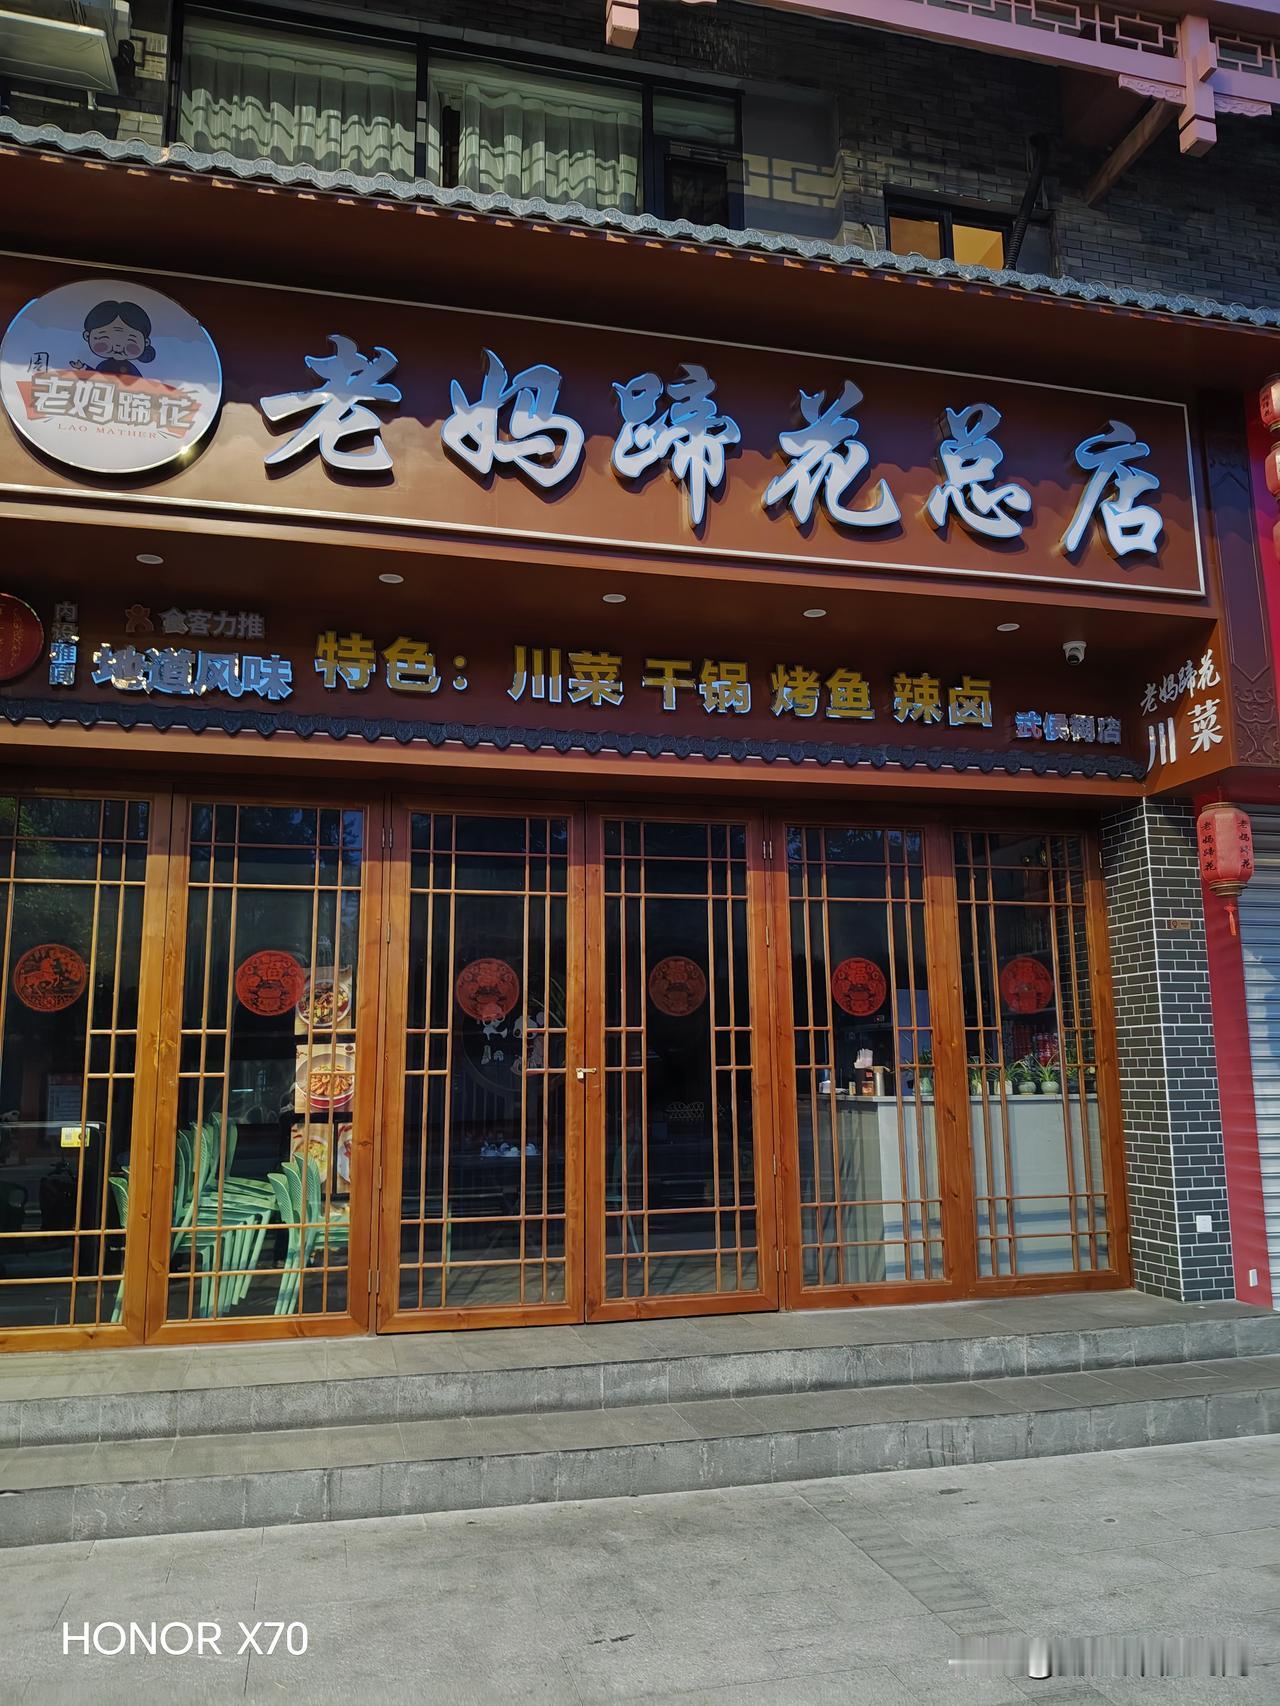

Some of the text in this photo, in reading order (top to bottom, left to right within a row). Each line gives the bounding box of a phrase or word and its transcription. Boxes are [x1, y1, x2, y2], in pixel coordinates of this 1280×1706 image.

[27, 352, 50, 373] 周
[33, 375, 196, 430] 老妈蹄花
[58, 423, 157, 440] LAO MATHER
[260, 335, 1163, 556] 老妈蹄花总店
[160, 607, 265, 639] 食客力推
[91, 642, 293, 700] 地道风味
[507, 645, 625, 706] 川菜
[642, 658, 751, 714] 干锅
[769, 664, 876, 720] 烤鱼
[893, 672, 994, 728] 辣卤
[1146, 698, 1224, 773] 川菜
